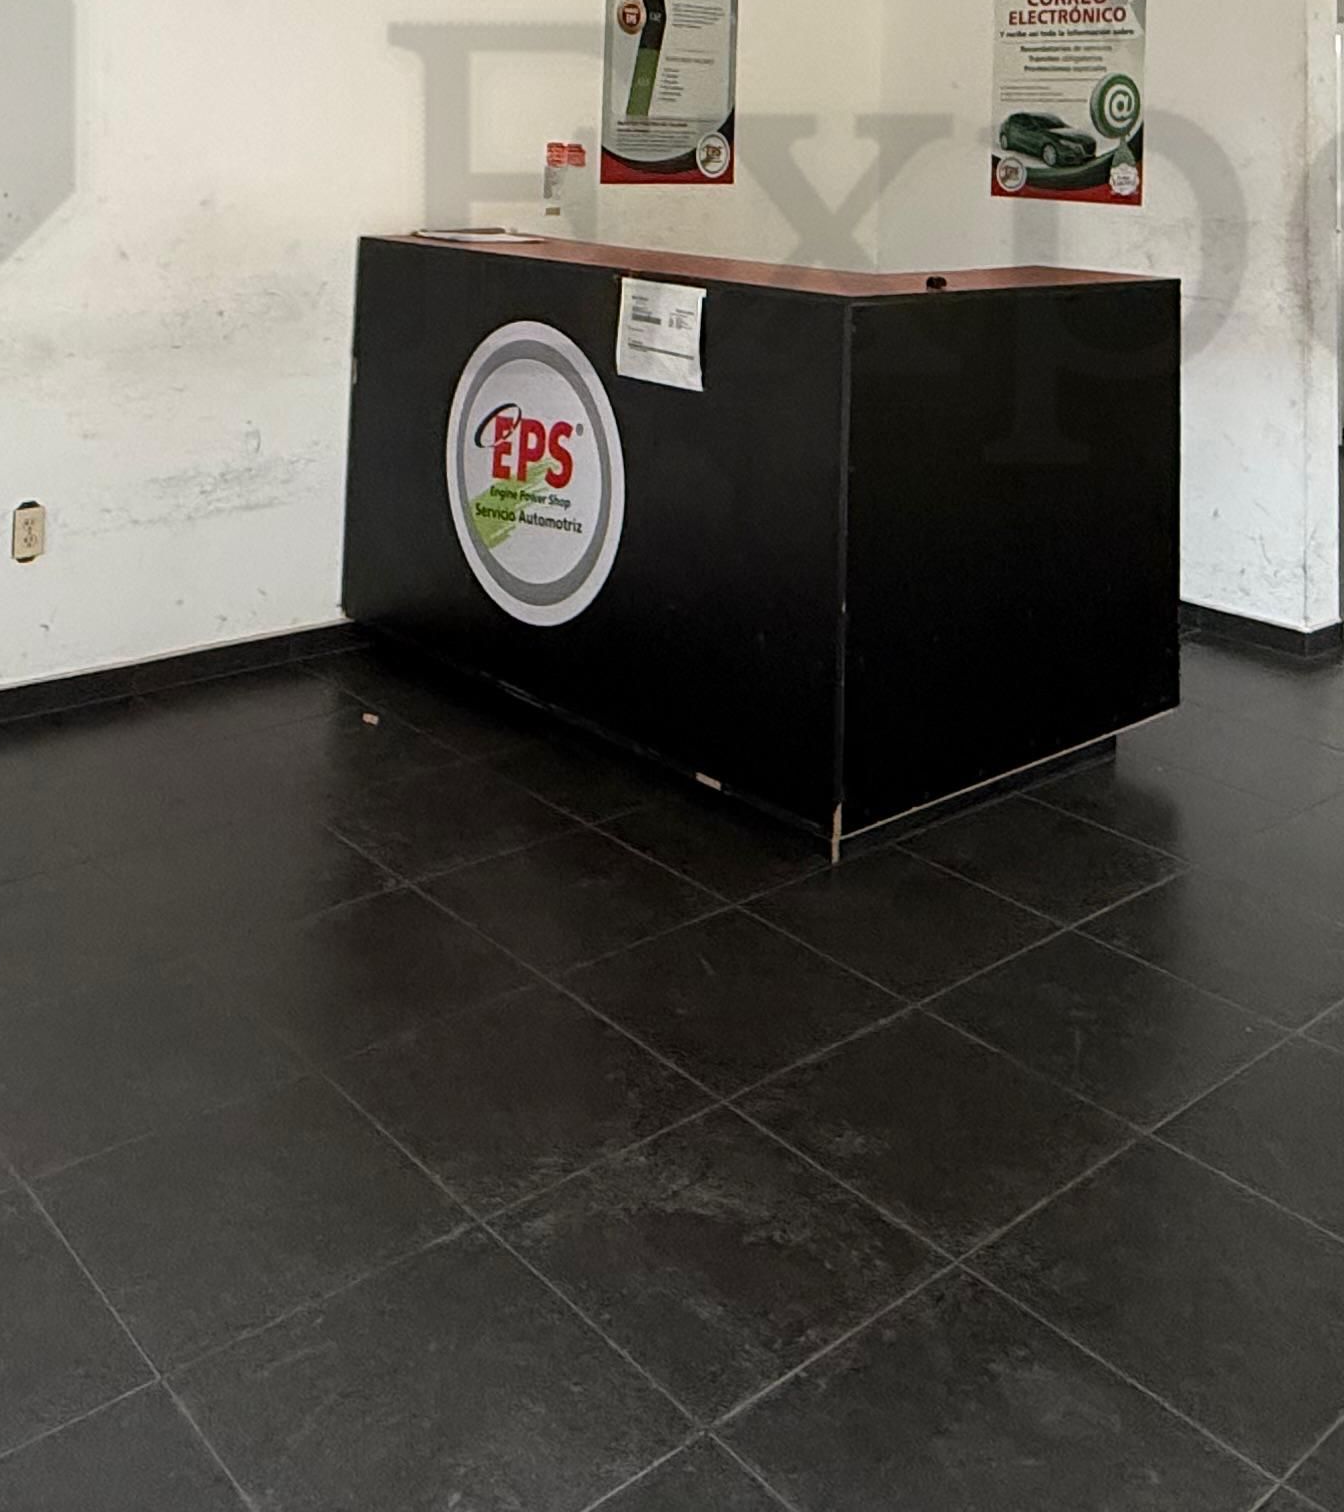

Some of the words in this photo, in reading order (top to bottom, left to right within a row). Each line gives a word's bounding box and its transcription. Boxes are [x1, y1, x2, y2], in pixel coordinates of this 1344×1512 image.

[1009, 5, 1127, 26] ELECTRÓNICO
[492, 414, 574, 489] EPS
[489, 485, 518, 501] Engine
[519, 490, 547, 504] Power
[548, 494, 571, 510] Shop
[475, 502, 516, 522] Servicio
[518, 510, 583, 534] Automotriz
